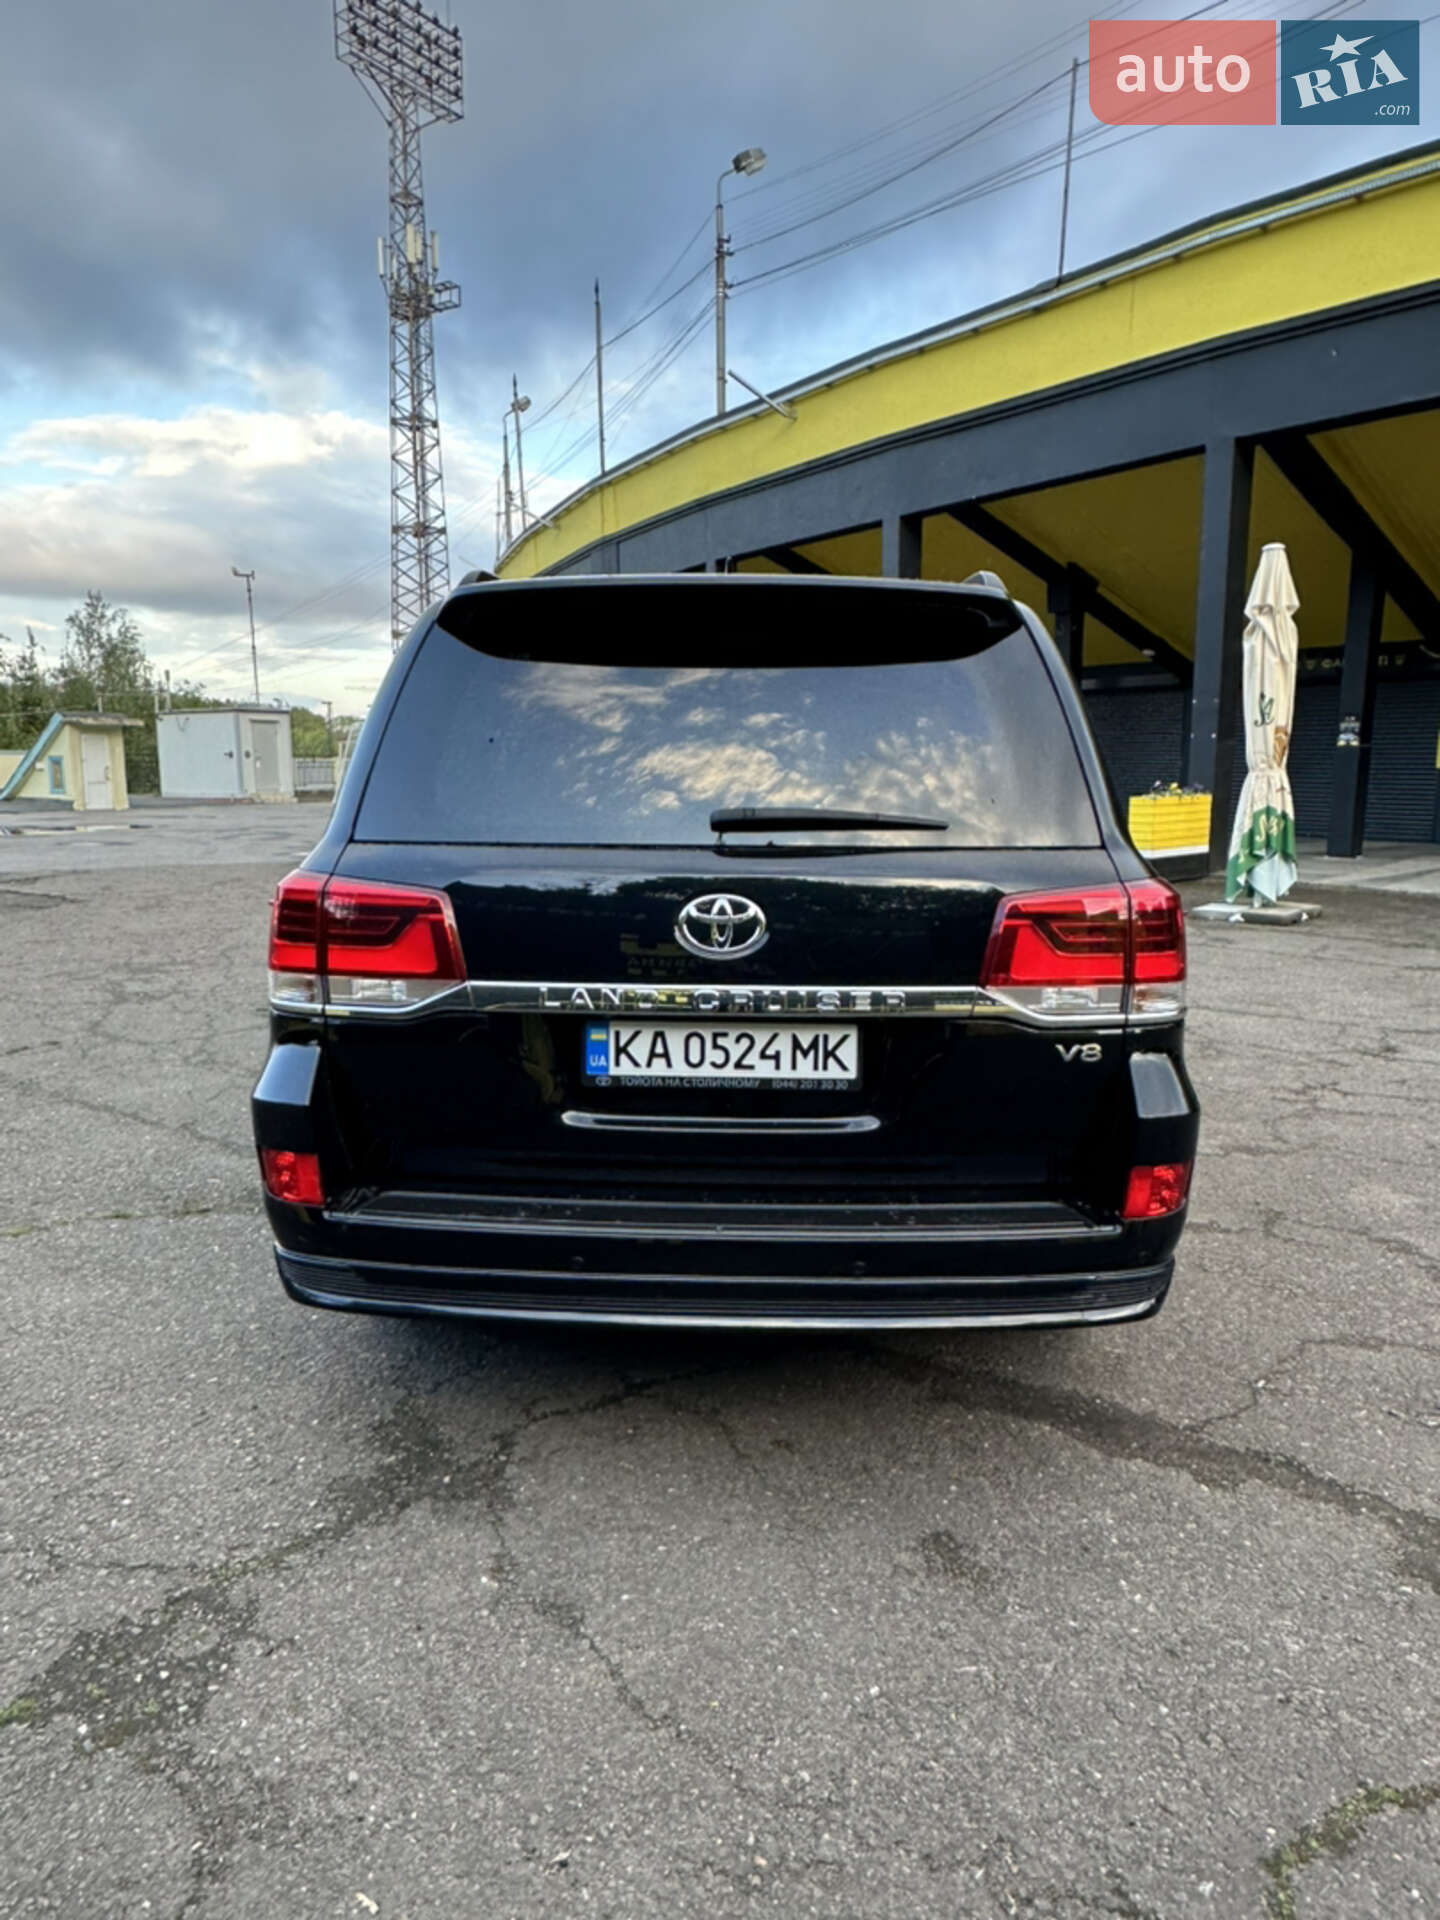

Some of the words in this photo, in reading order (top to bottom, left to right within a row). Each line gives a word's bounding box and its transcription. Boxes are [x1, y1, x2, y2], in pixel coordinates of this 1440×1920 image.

[539, 986, 658, 1009] LAND
[693, 988, 906, 1012] CRUISER
[589, 1054, 608, 1068] UA
[1055, 1043, 1103, 1062] V8
